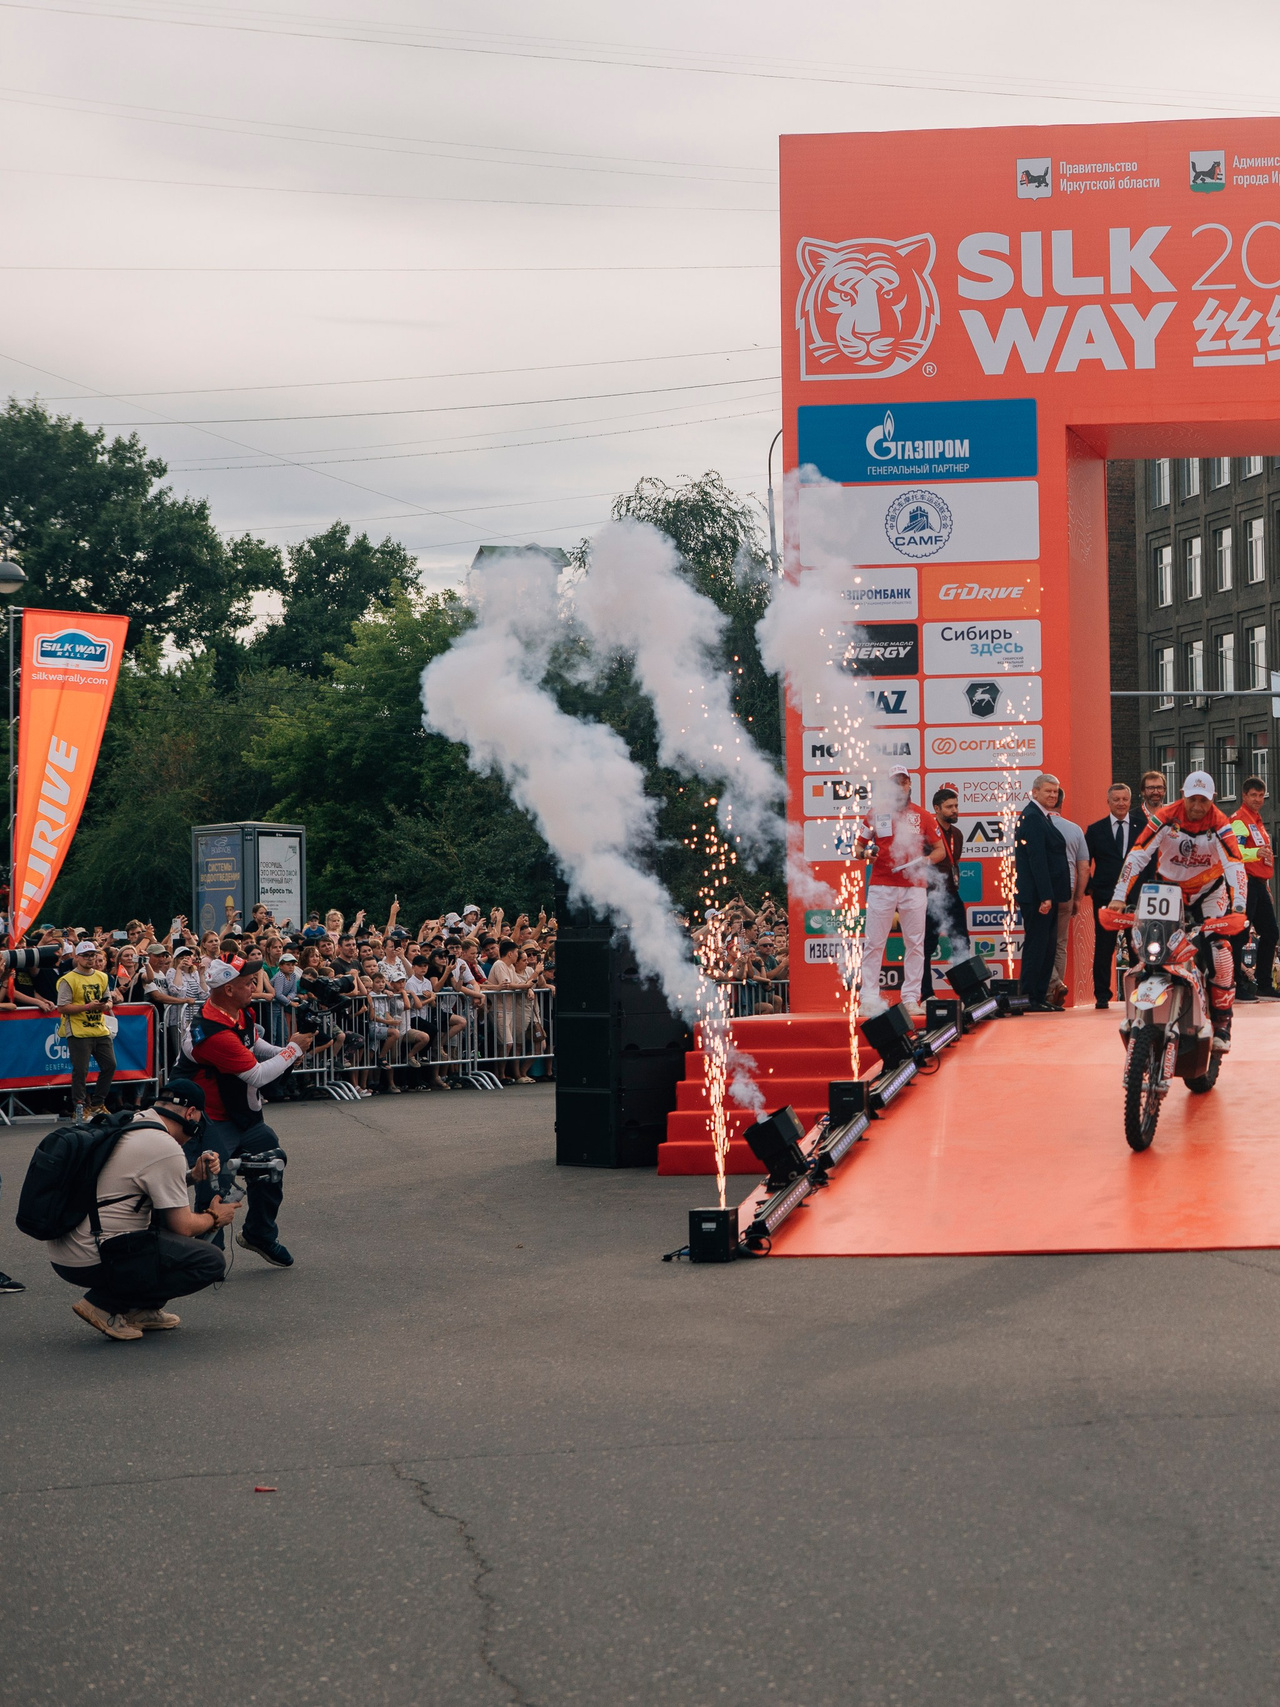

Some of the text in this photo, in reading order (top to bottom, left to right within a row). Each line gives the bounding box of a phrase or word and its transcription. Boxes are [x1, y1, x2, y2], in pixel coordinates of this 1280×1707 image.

[1059, 161, 1138, 174] Правительство
[1059, 175, 1161, 193] Иркутской области
[1233, 172, 1269, 186] города
[957, 225, 1178, 300] SILK
[958, 300, 1178, 375] WAY
[896, 439, 970, 460] ГАЗПРОМ
[867, 463, 970, 476] ГЕНЕРАЛЬНЫЙ ПАРТНЕР
[895, 535, 943, 546] CAMF
[941, 625, 1013, 644] Сибирь
[41, 641, 106, 655] SILK WAY
[970, 642, 1024, 657] здесь
[963, 780, 1022, 791] РУССКАЯ
[208, 862, 233, 872] СИСТЕМЫ
[261, 887, 269, 895] Да
[269, 886, 285, 896] брось
[1147, 897, 1170, 916] 50
